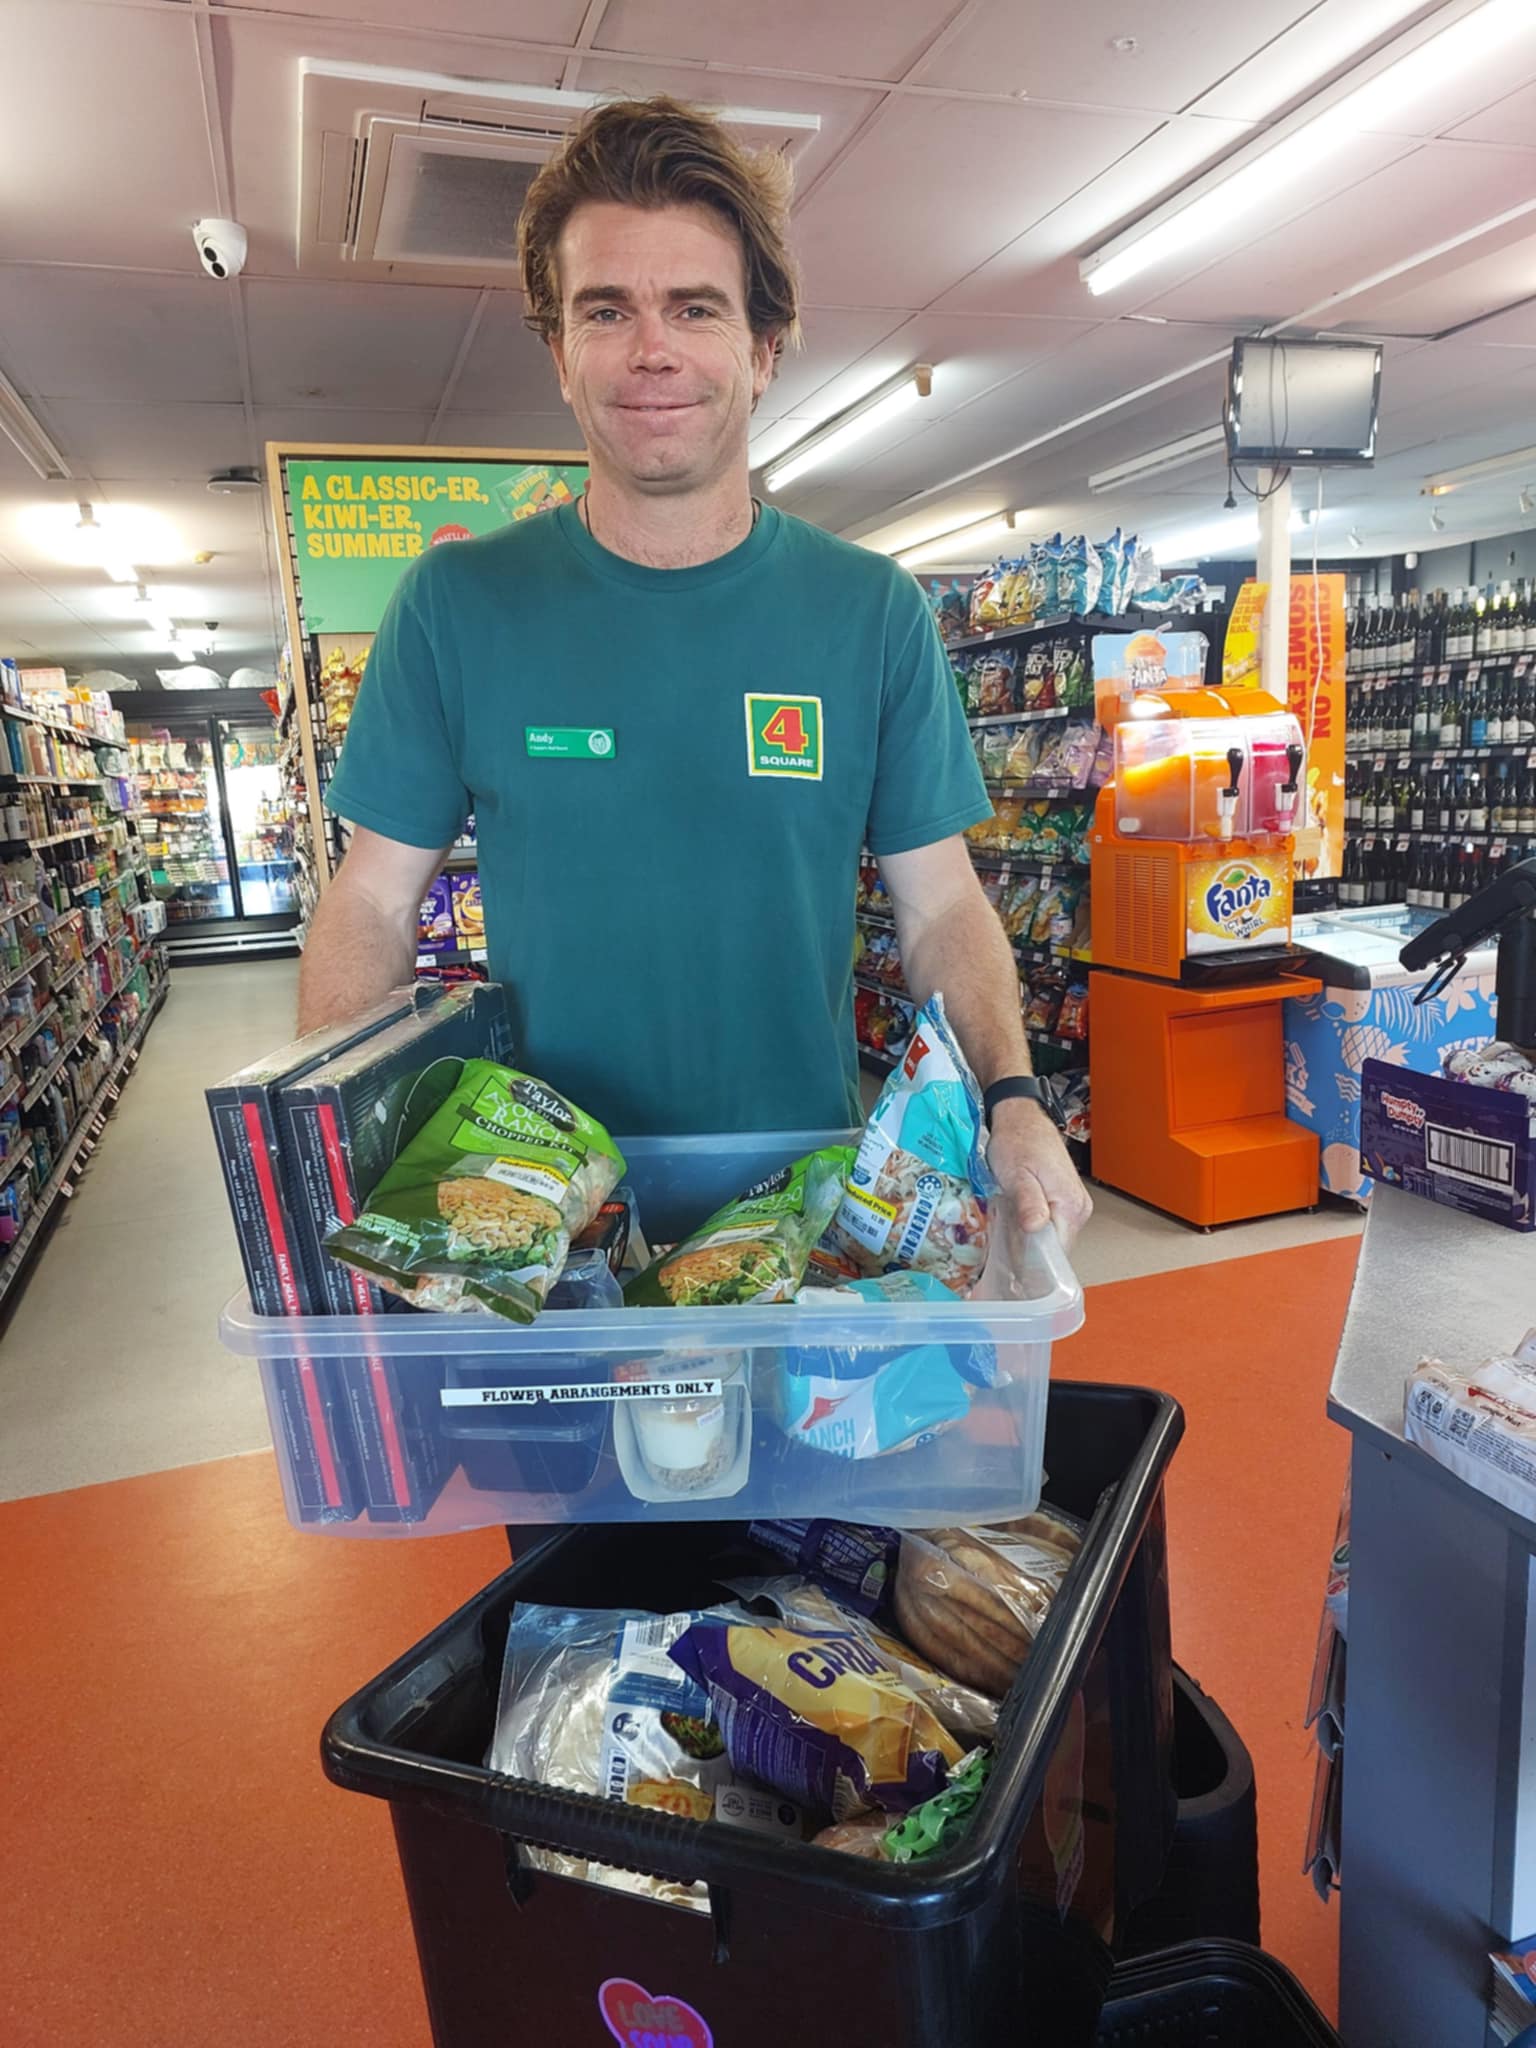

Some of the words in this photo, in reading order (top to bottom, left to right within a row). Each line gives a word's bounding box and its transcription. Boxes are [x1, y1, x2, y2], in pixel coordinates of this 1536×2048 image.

[302, 475, 321, 500] A
[326, 476, 490, 504] CLASSIC-ER,
[304, 504, 421, 532] KIWI-ER,
[307, 533, 424, 558] SUMMER
[1289, 584, 1306, 671] SOME
[1310, 583, 1332, 688] CHUCK
[762, 706, 809, 755] 4
[1312, 695, 1332, 739] ON
[760, 755, 814, 769] SQUARE
[1206, 875, 1271, 923] Fanta
[524, 1079, 572, 1122] Taylor
[1381, 1091, 1416, 1113] Humpty
[475, 1115, 545, 1146] CHOPPED
[1386, 1104, 1424, 1129] Dumpty
[482, 1389, 545, 1402] FLOWER
[549, 1384, 671, 1400] ARRANGEMENTS
[675, 1381, 715, 1394] ONLY
[617, 2000, 685, 2032] LOVE
